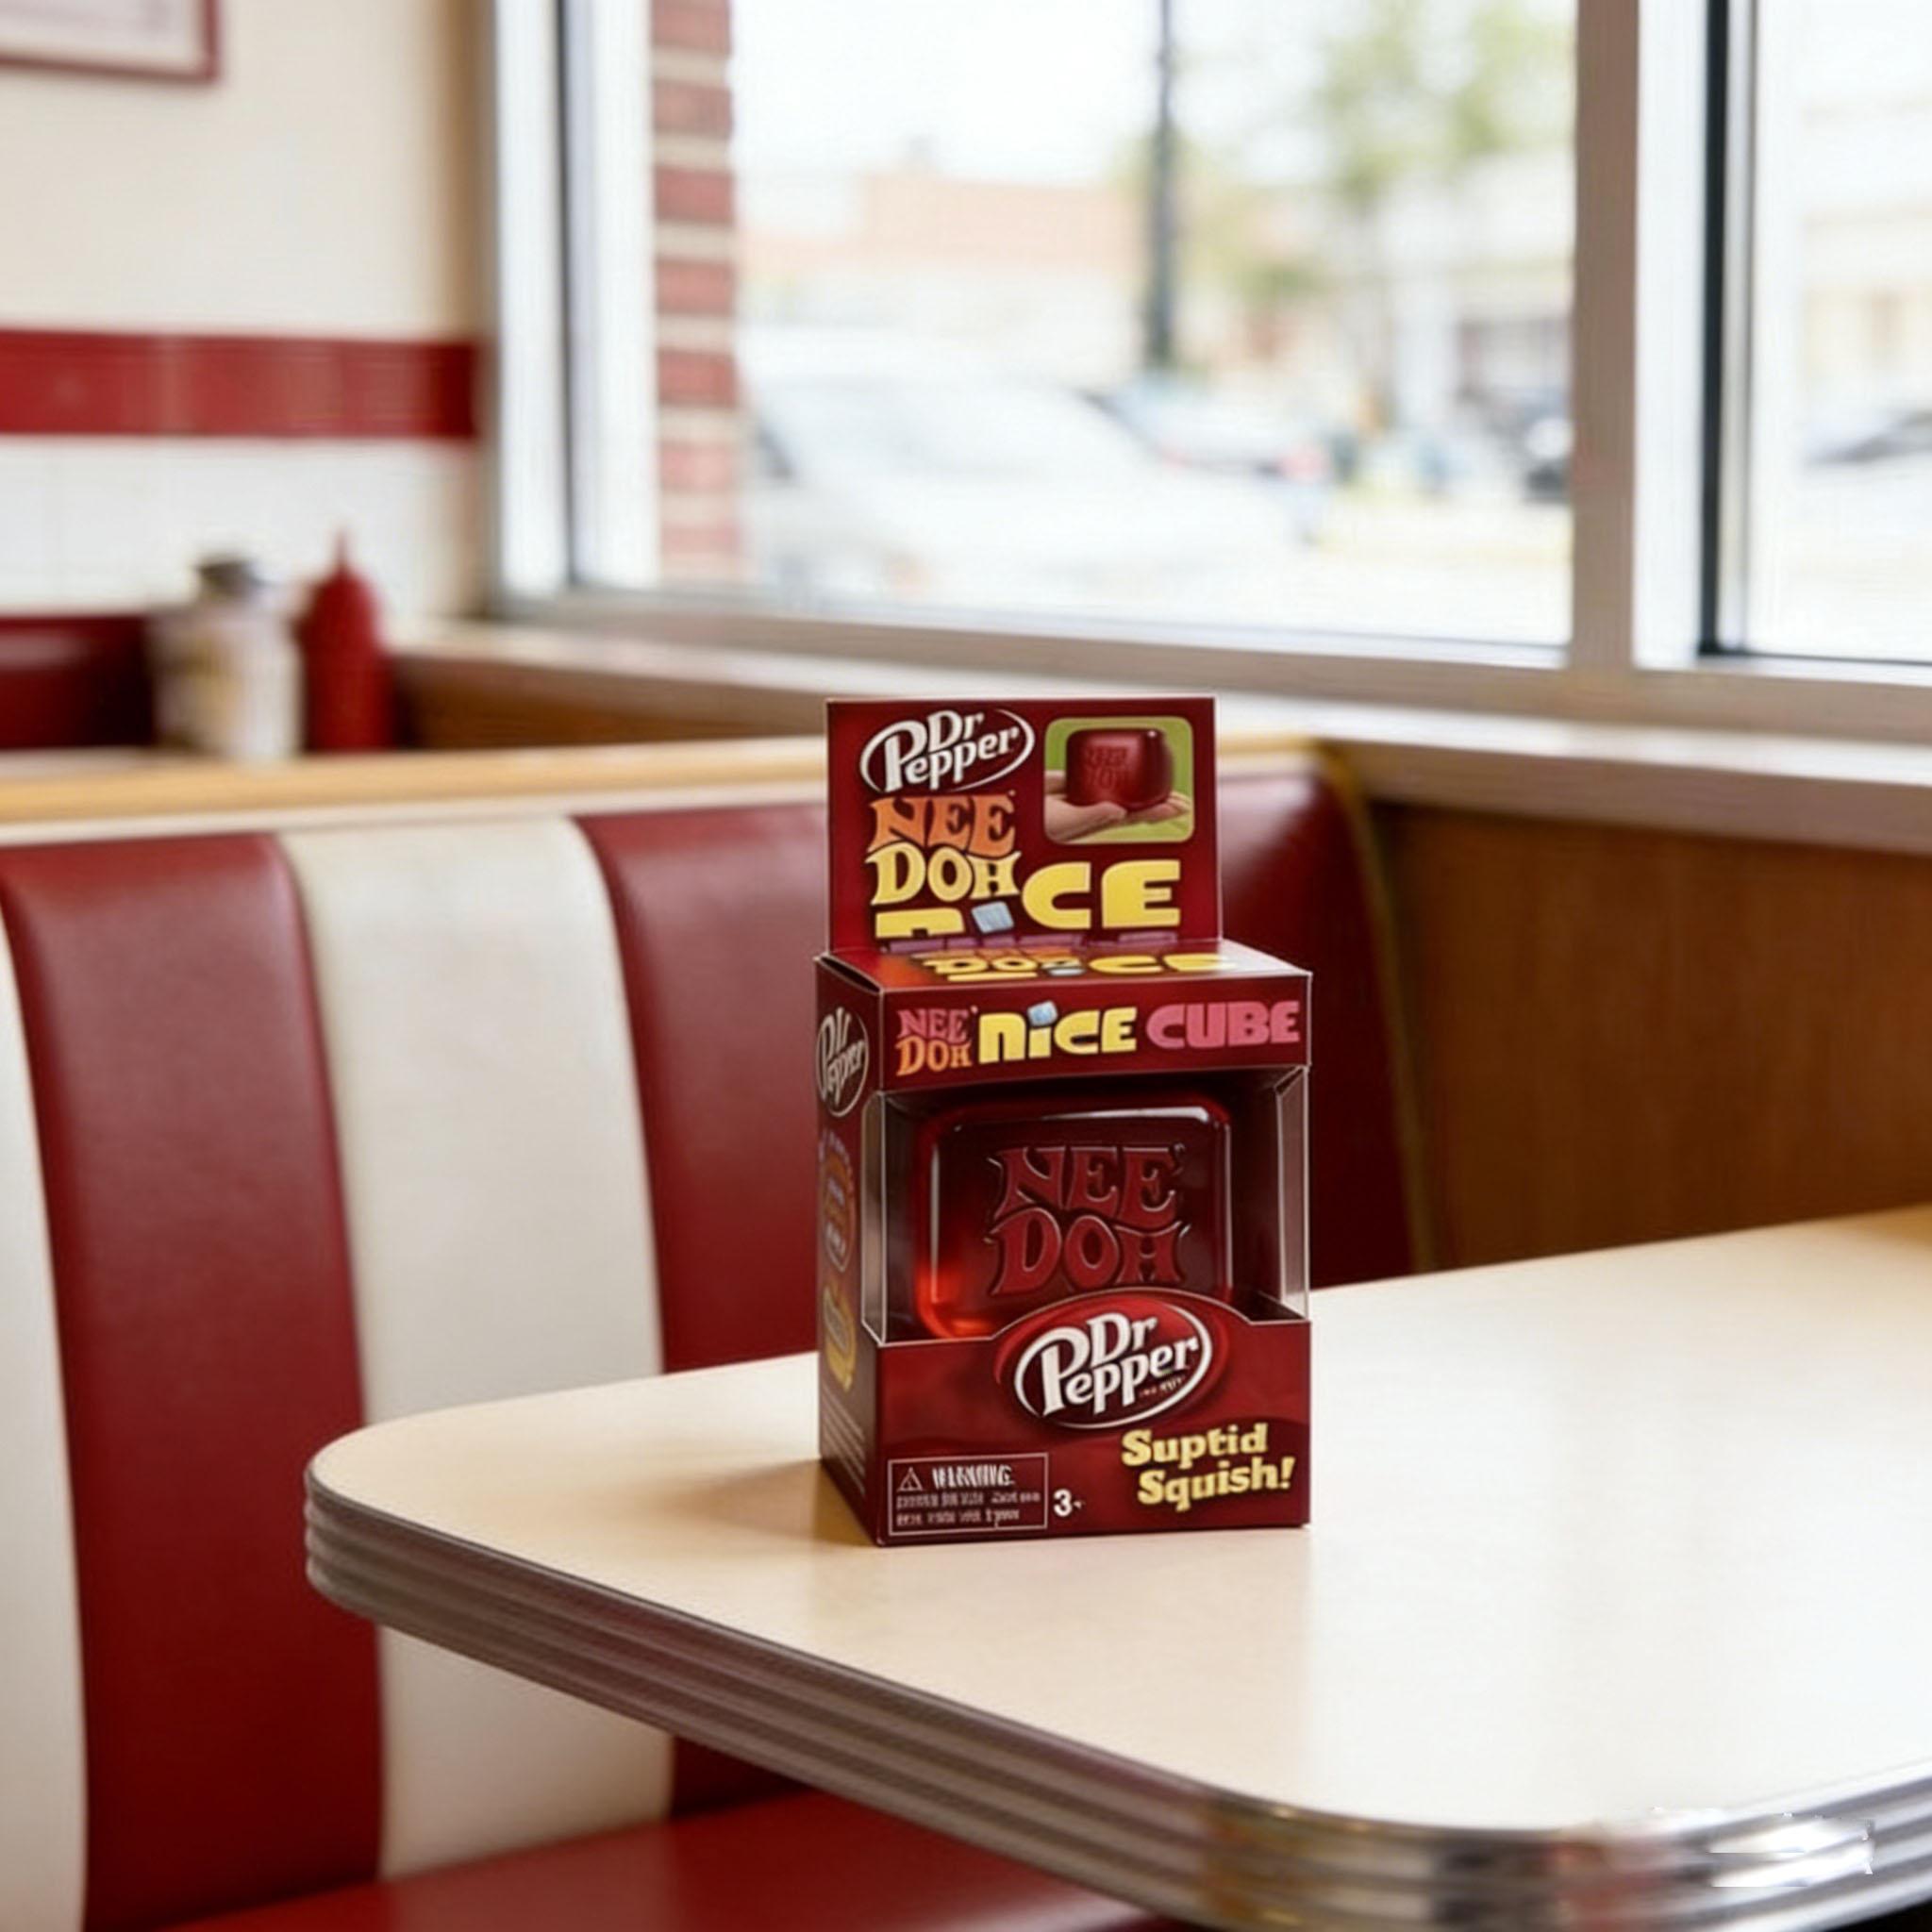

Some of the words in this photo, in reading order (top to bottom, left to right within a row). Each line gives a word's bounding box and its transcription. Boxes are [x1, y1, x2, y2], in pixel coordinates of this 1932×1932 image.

[882, 721, 1020, 793] Pepper
[927, 709, 984, 753] Dr
[867, 794, 1016, 858] NEE
[865, 841, 1022, 906] DOH
[897, 1007, 971, 1043] NEE
[1145, 1001, 1300, 1049] CUBE
[895, 1035, 973, 1076] DOH
[987, 1145, 1178, 1229] NEE
[983, 1207, 1191, 1295] DOH
[1087, 1312, 1158, 1369] Dr
[1041, 1326, 1199, 1416] Pepper
[1122, 1423, 1268, 1470] Suptid
[1137, 1457, 1296, 1513] Squish!
